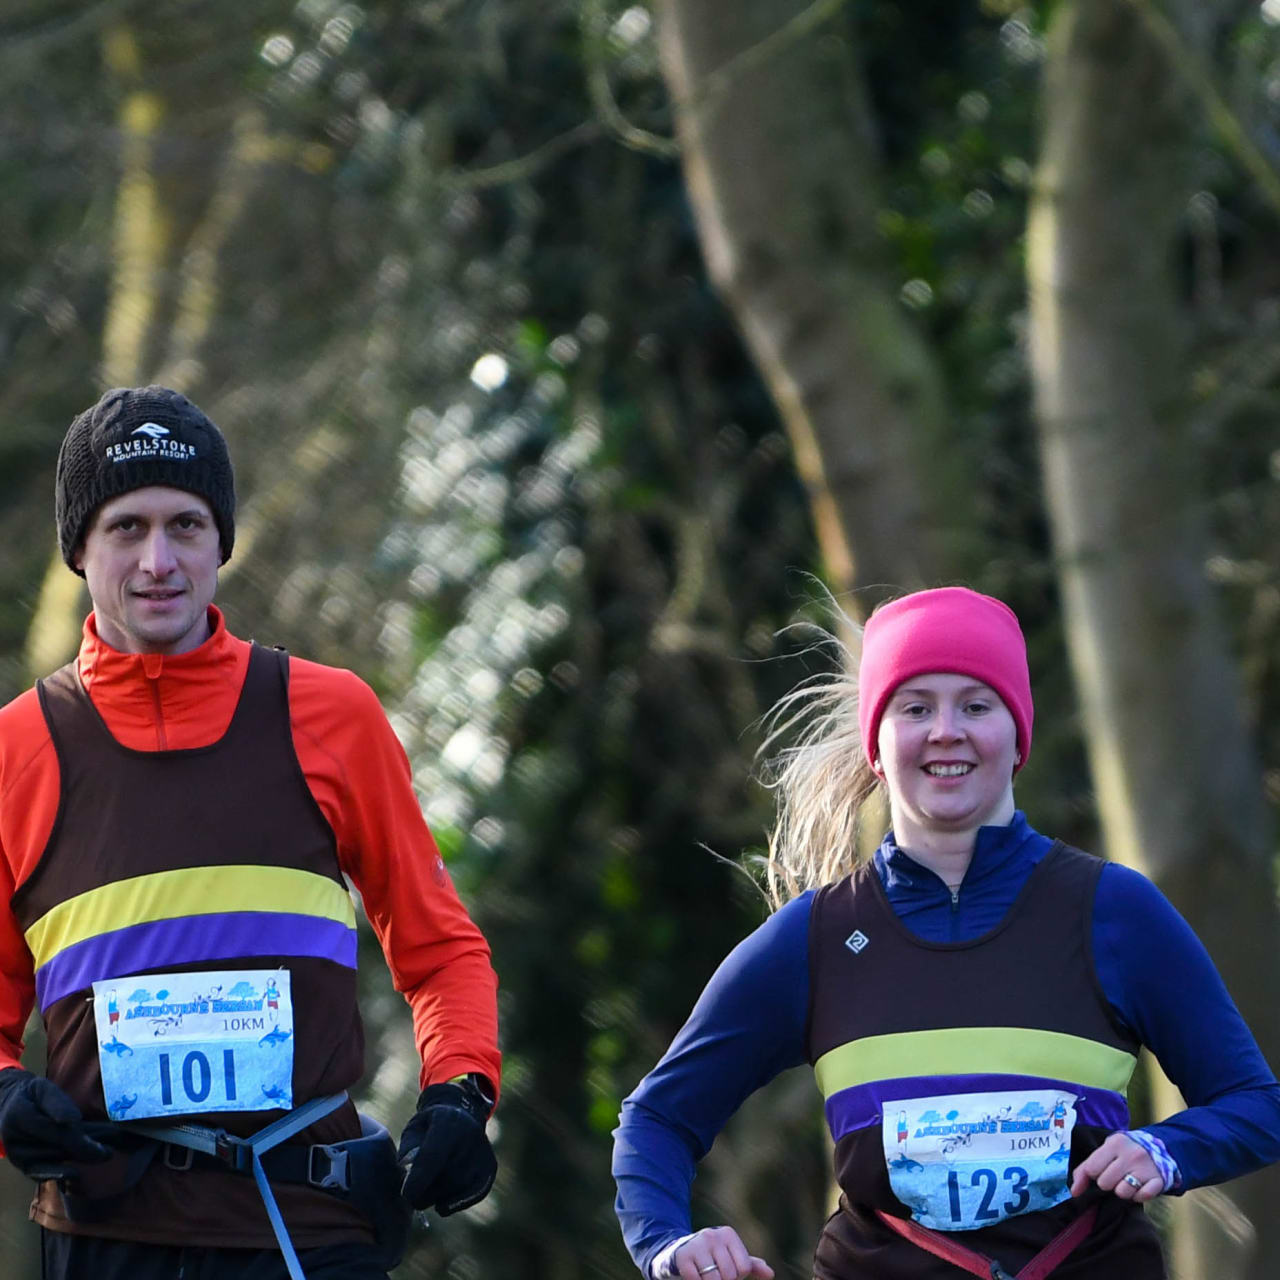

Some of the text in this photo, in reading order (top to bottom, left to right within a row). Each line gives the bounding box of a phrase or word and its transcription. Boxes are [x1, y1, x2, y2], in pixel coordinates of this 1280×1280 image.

[106, 439, 195, 456] REVELSTOKE
[113, 449, 189, 461] MOUNTAIN RESORT
[223, 1017, 265, 1031] 10KM
[159, 1049, 237, 1106] 101
[1010, 1136, 1050, 1150] 10KM
[947, 1166, 1031, 1223] 123
